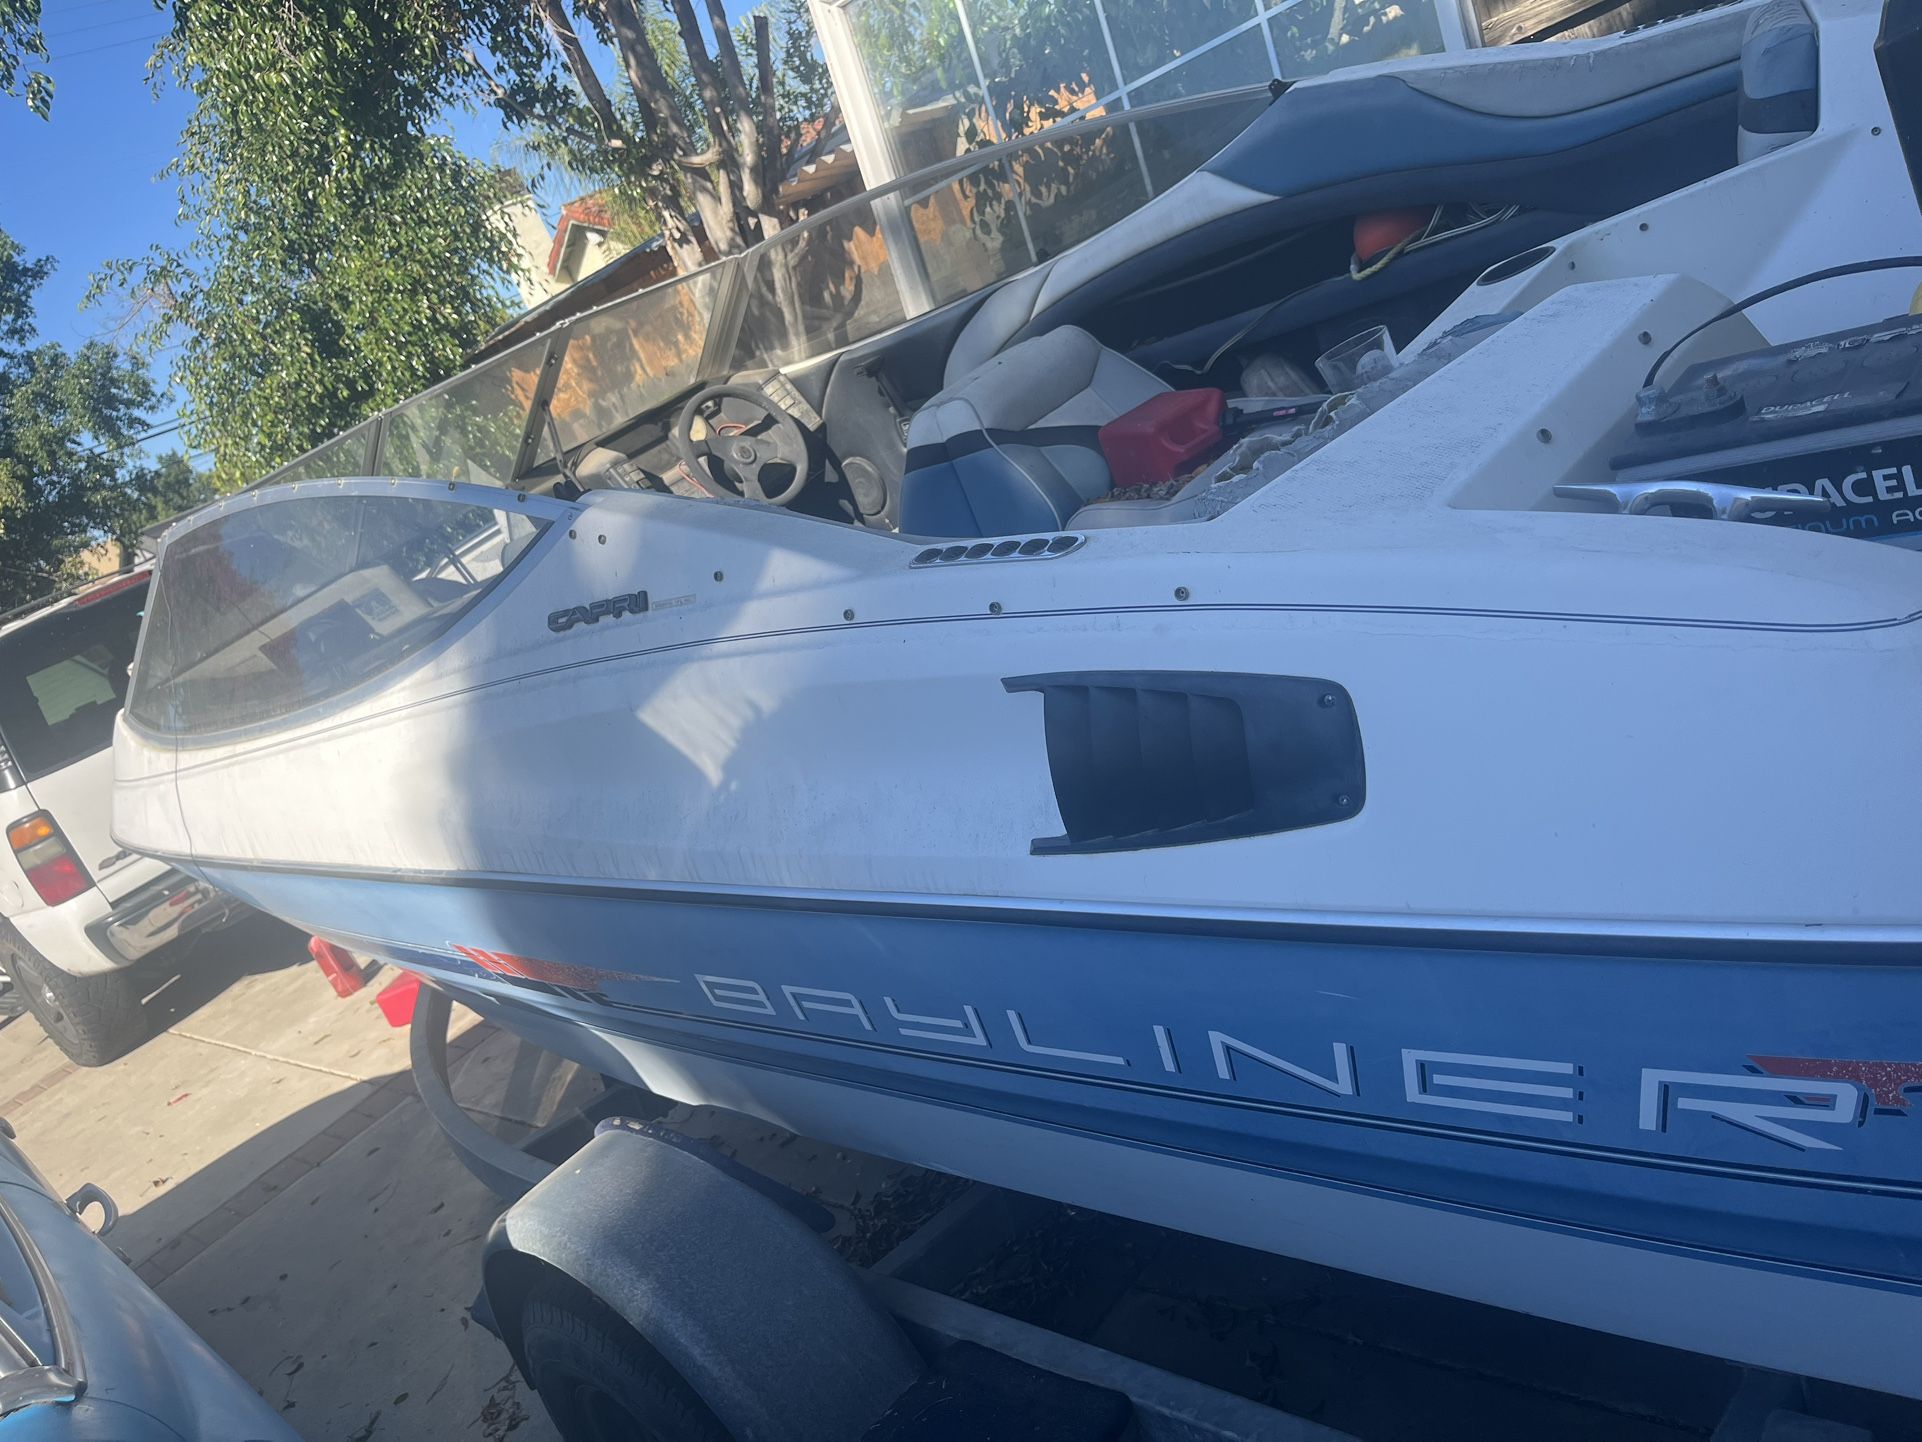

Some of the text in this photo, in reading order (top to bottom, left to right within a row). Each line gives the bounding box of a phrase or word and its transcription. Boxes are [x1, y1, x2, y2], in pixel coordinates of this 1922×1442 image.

[1750, 464, 1922, 519] ACEL
[547, 590, 649, 633] CAPRI
[694, 973, 1862, 1151] BAYLINER
